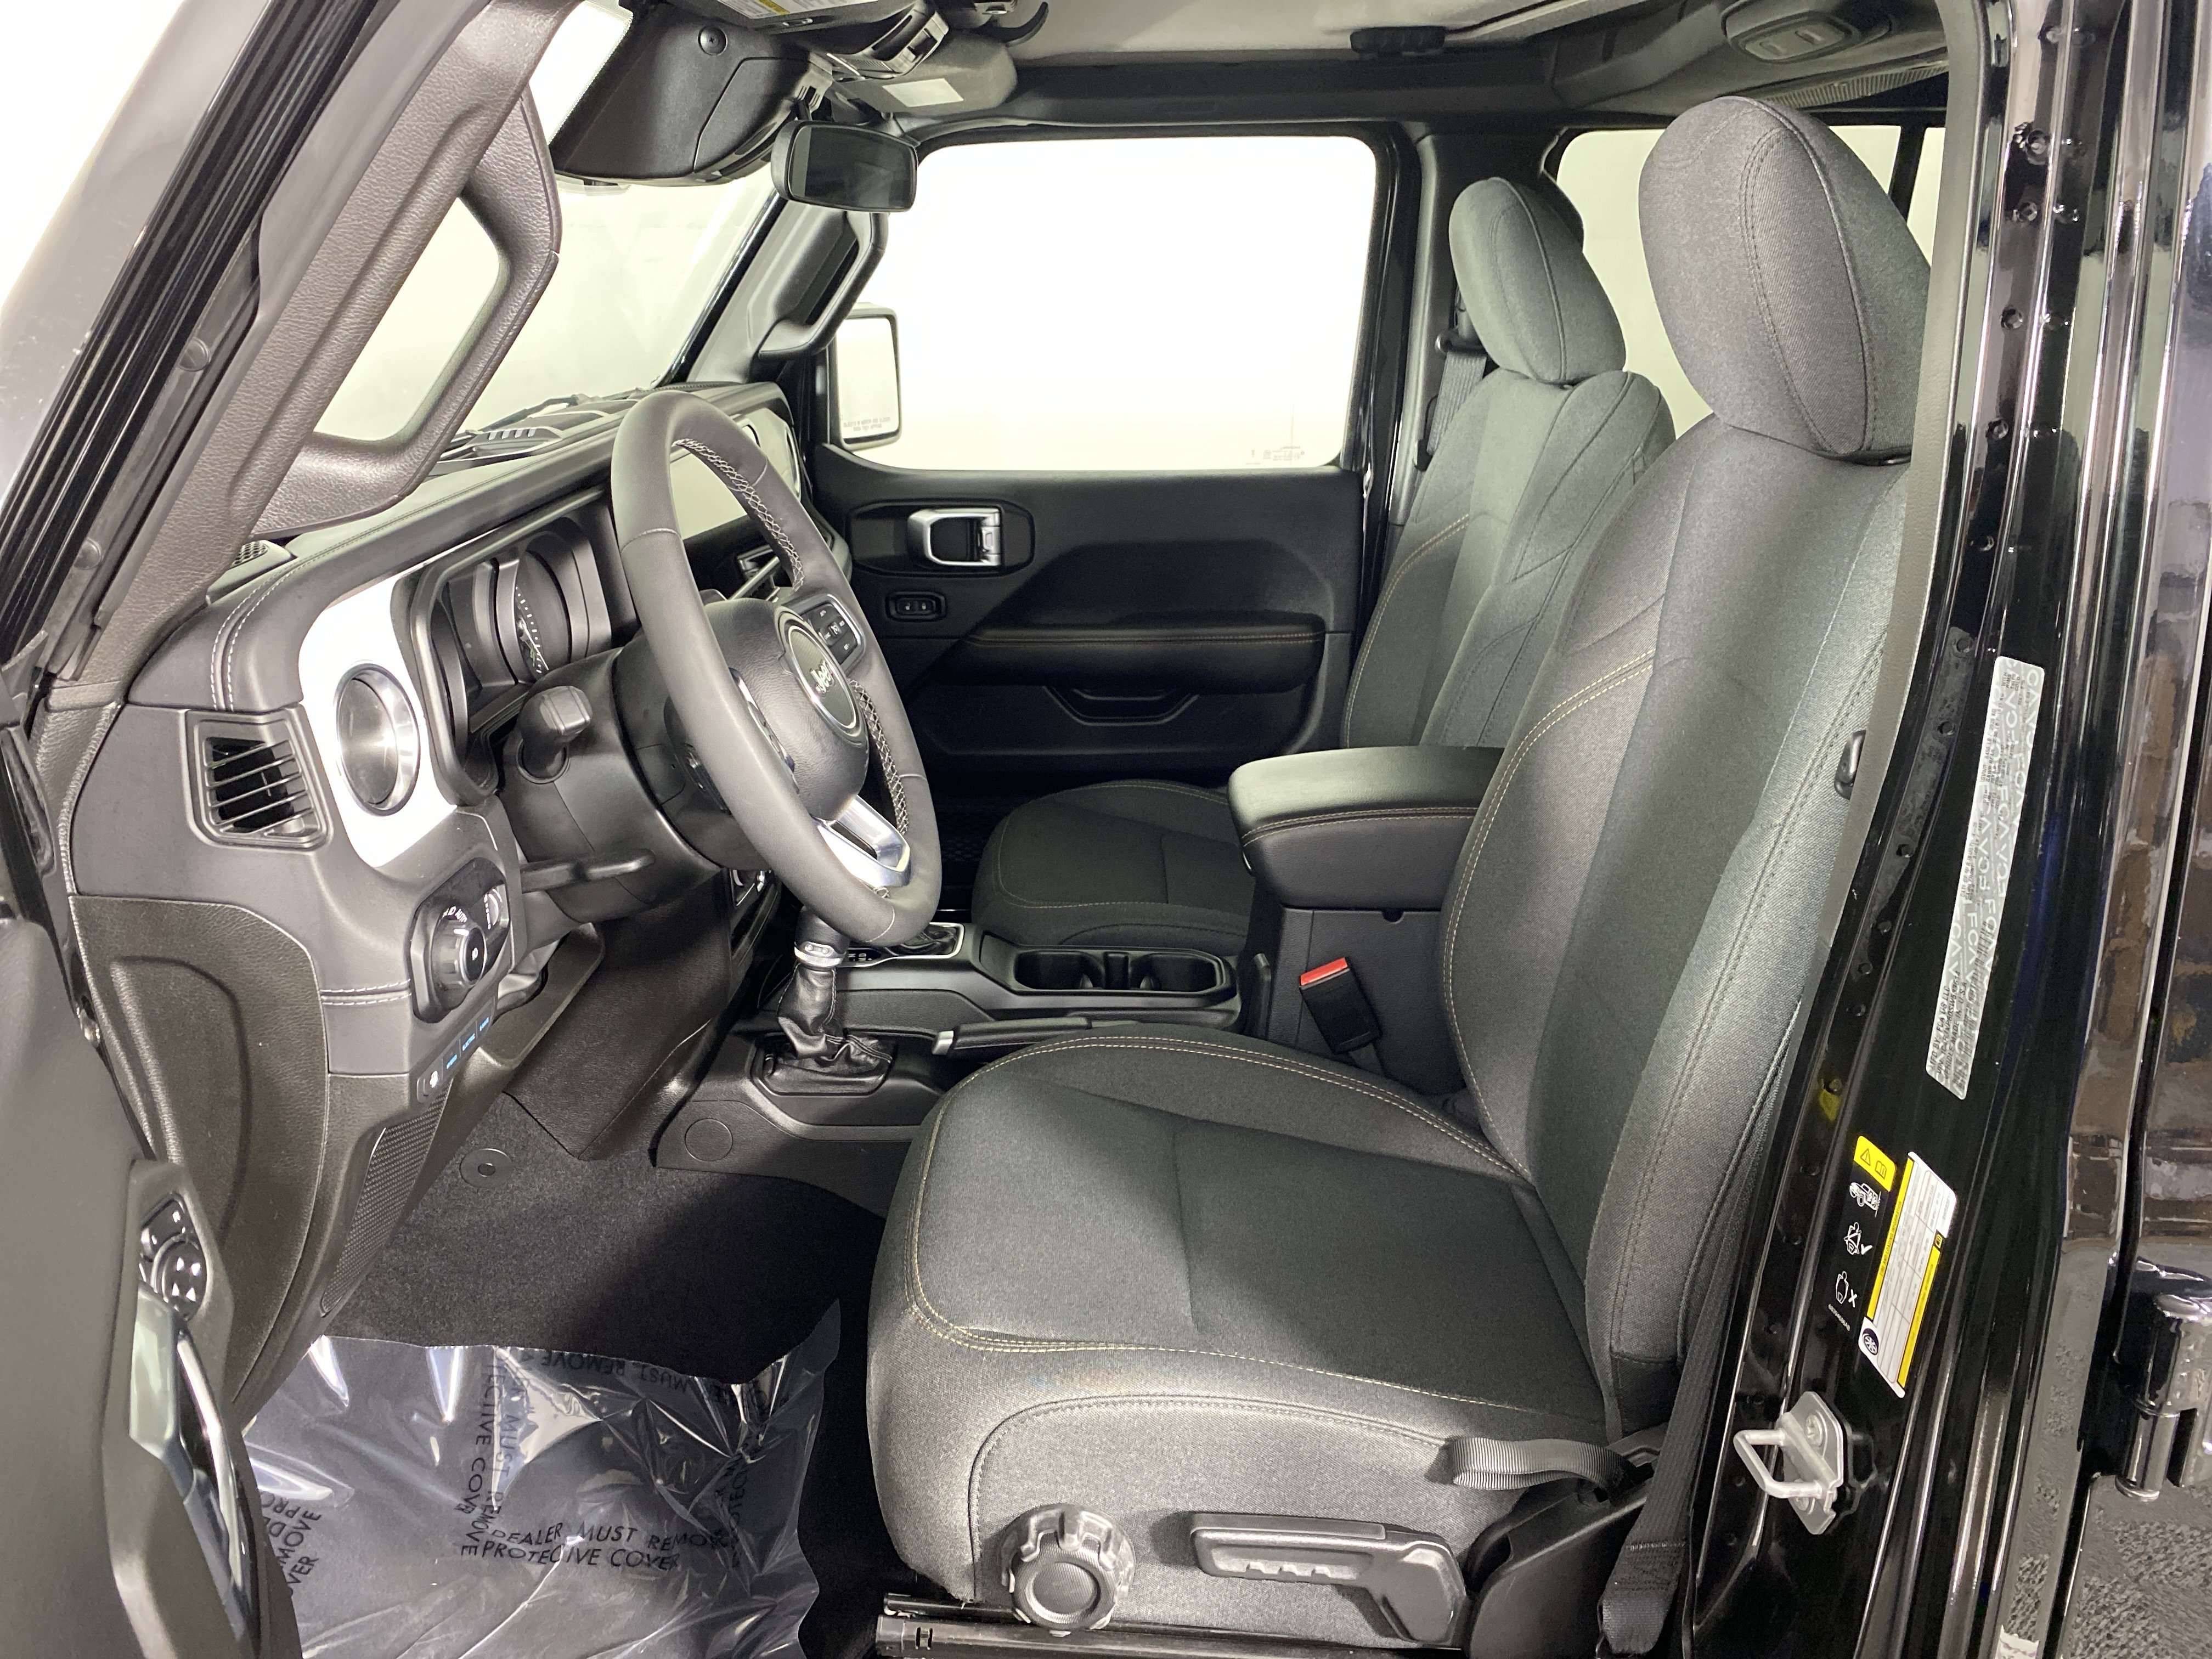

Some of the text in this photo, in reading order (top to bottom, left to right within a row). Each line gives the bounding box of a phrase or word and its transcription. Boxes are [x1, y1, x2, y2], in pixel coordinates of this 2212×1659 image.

[811, 660, 831, 693] Jeep
[1942, 984, 1950, 1002] LLC
[491, 1522, 563, 1547] DEALER
[577, 1521, 639, 1543] MUST
[482, 1540, 681, 1571] PROTECIVE COVER
